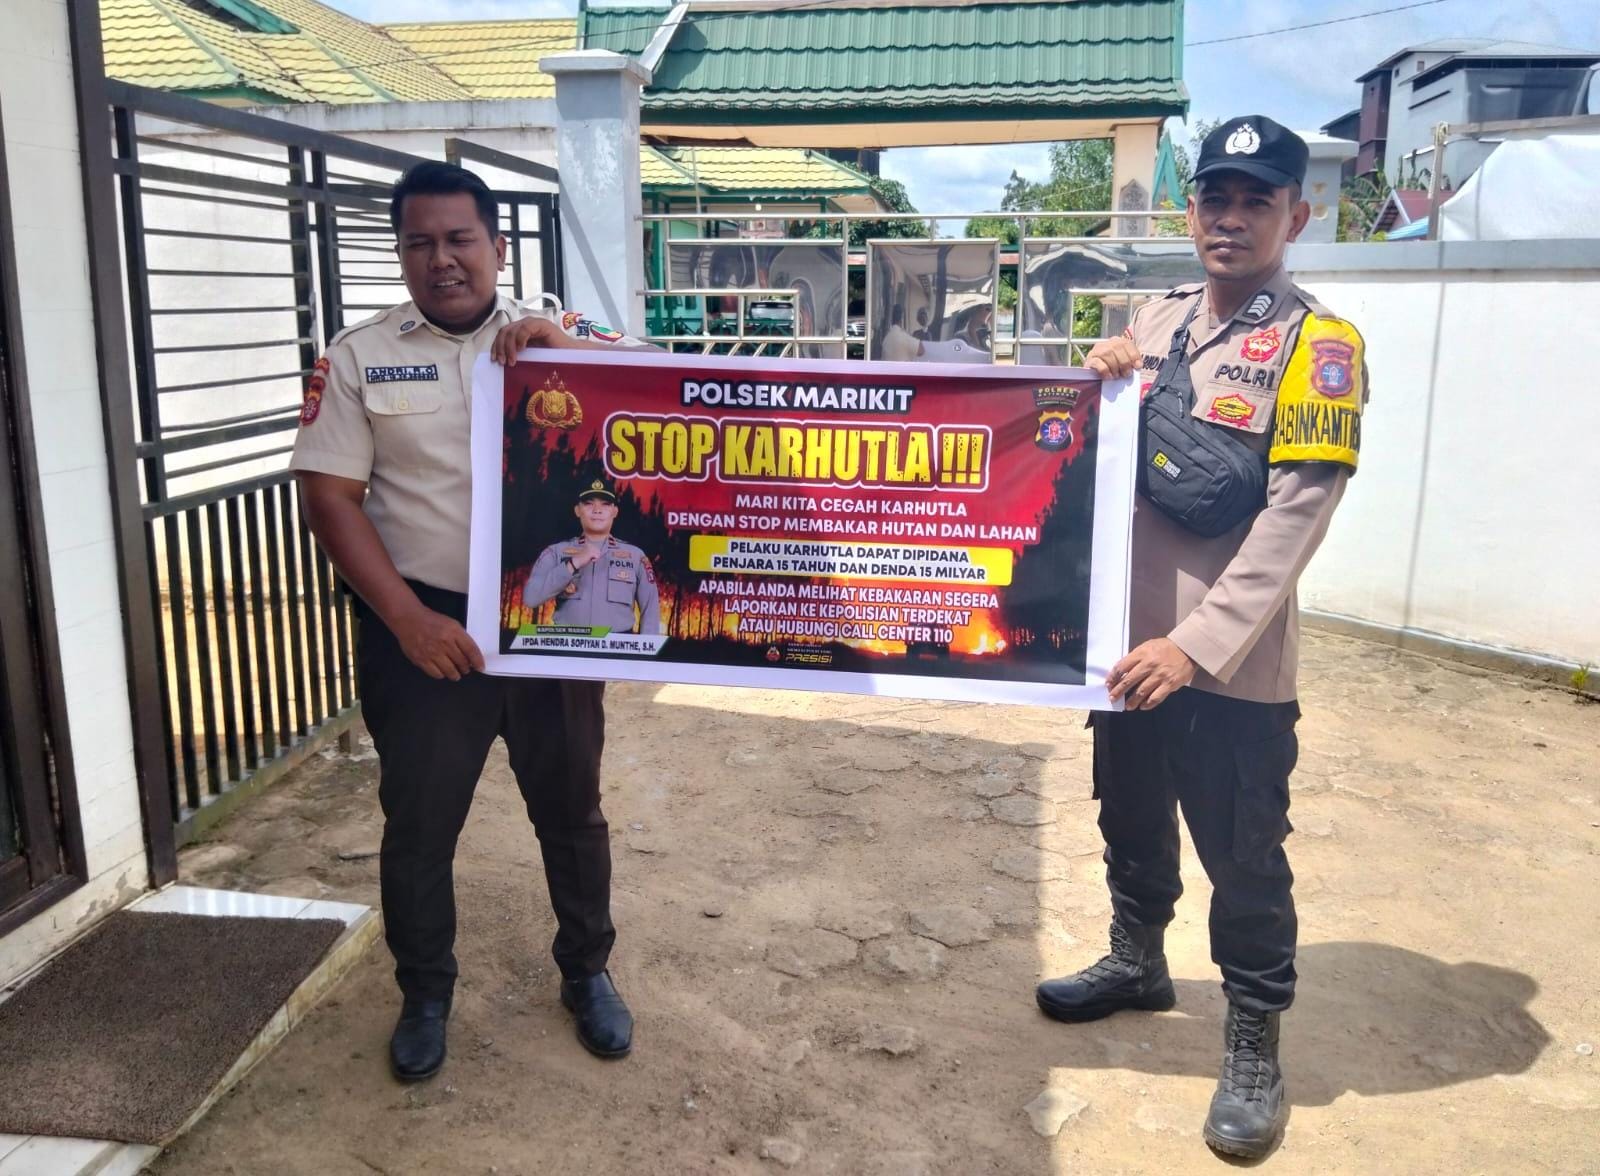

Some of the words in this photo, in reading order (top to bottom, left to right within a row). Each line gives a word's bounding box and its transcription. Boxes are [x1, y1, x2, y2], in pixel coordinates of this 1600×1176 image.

[1215, 364, 1276, 388] POLRI
[683, 382, 788, 407] POLSEK
[793, 386, 913, 411] MARIKIT
[611, 419, 714, 474] STOP
[724, 425, 931, 483] KARHUTLA
[941, 433, 985, 484] !!!
[735, 494, 778, 509] MARI
[782, 496, 817, 511] KITA
[820, 498, 877, 514] CEGAH
[881, 501, 967, 517] KARHUTLA
[668, 512, 735, 528] DENGAN
[739, 515, 781, 530] STOP
[784, 518, 878, 535] MEMBAKAR
[881, 522, 937, 537] HUTAN
[941, 524, 975, 538] DAN
[980, 525, 1037, 541] LAHAN
[730, 541, 781, 555] PELAKU
[784, 544, 853, 558] KARHUTLA
[857, 547, 900, 560] DAPAT
[903, 549, 969, 563] DIPIDANA
[609, 560, 634, 569] POLRI
[713, 556, 774, 571] PENJARA
[777, 560, 789, 571] 15
[791, 560, 836, 573] TAHUN
[840, 563, 868, 575] DAN
[871, 564, 917, 577] DENDA
[919, 566, 932, 578] 15
[935, 567, 985, 580] MILYAR
[698, 580, 755, 596] APABILA
[757, 583, 796, 598] ANDA
[798, 585, 857, 601] MELIHAT
[859, 588, 942, 606] KEBAKARAN
[945, 592, 999, 608] SEGERA
[724, 600, 797, 615] LAPORKAN
[800, 603, 816, 616] KE
[819, 604, 899, 622] KEPOLISIAN
[902, 608, 971, 625] TERDEKAT
[739, 618, 773, 633] ATAU
[776, 620, 839, 636] HUBUNGI
[841, 623, 876, 639] CALL
[878, 625, 931, 641] CENTER
[934, 629, 953, 643] 110
[522, 638, 539, 646] IPDA
[540, 638, 569, 648] HENDRA
[570, 639, 600, 649] SOPIYAN
[785, 653, 833, 665] PRESISI
